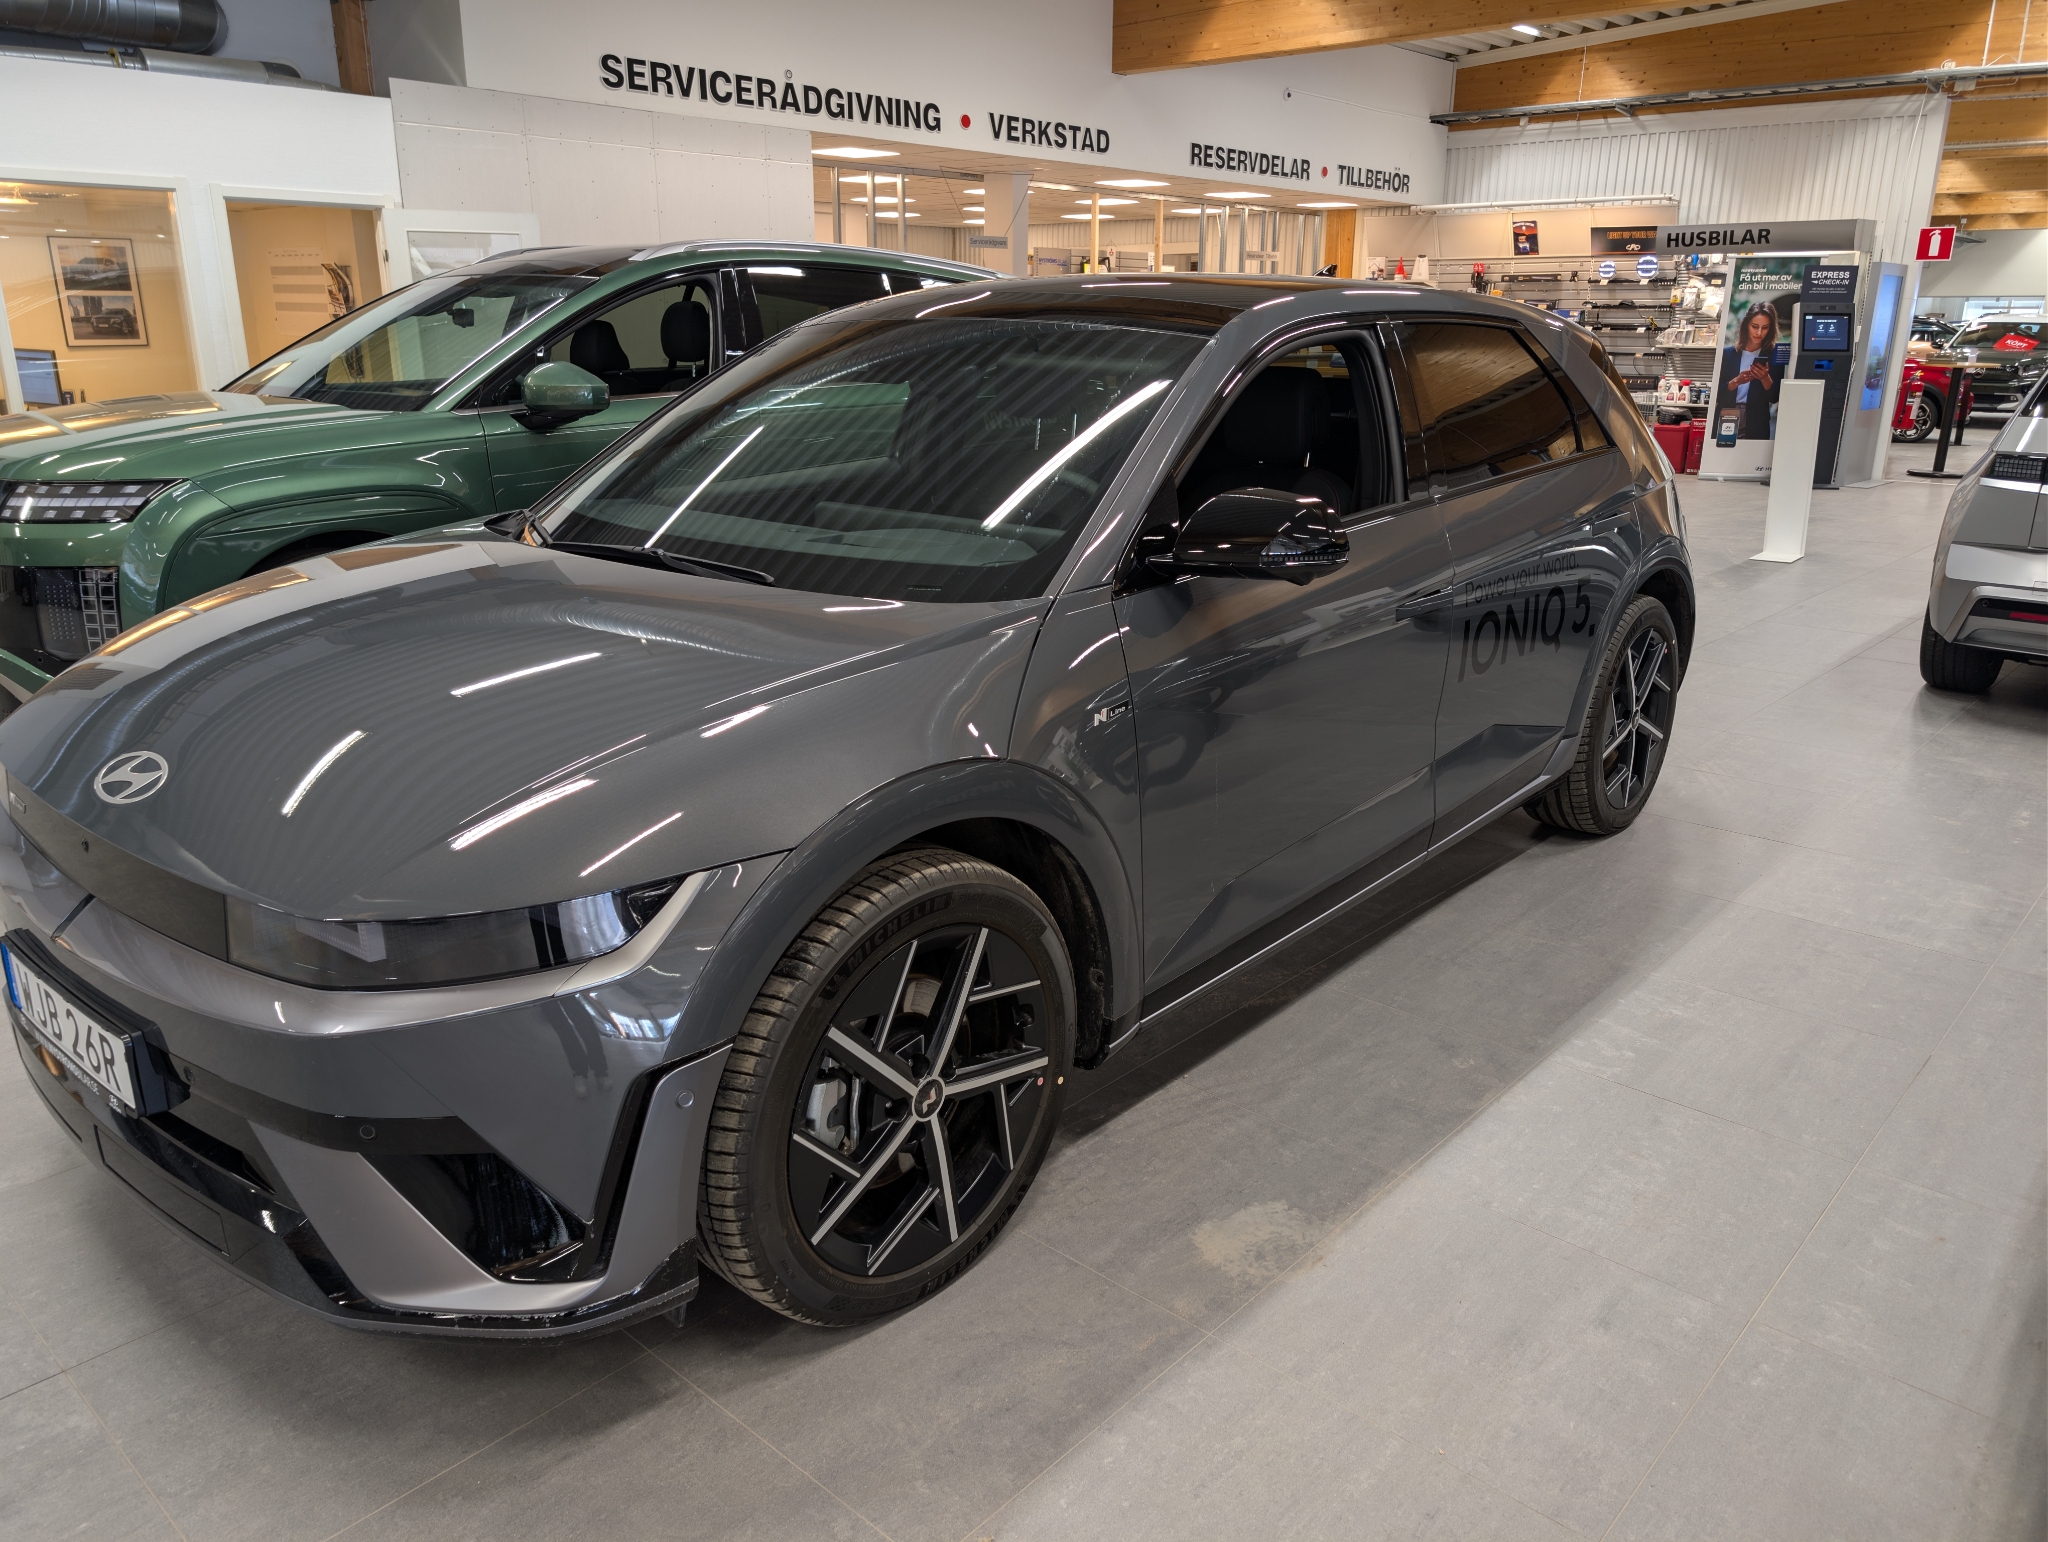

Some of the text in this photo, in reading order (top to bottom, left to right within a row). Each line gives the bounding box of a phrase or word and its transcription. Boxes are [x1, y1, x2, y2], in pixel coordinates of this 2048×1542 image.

[600, 53, 1110, 154] SERVICERÅDGIVNING VERKSTAD
[1190, 142, 1410, 194] RESERVDELAR TILLBEHÖR
[1666, 228, 1771, 248] HUSBILAR
[1738, 282, 1752, 290] din
[1753, 282, 1764, 290] bil
[1740, 273, 1751, 282] Få
[1751, 274, 1760, 282] ut
[1780, 274, 1792, 282] av
[1811, 271, 1850, 279] EXPRESS
[1465, 552, 1580, 607] Power your world.
[1457, 585, 1566, 684] IONIQ
[1094, 706, 1126, 727] N Line
[847, 894, 949, 973] MICHELIN
[15, 962, 123, 1094] WJB 26R
